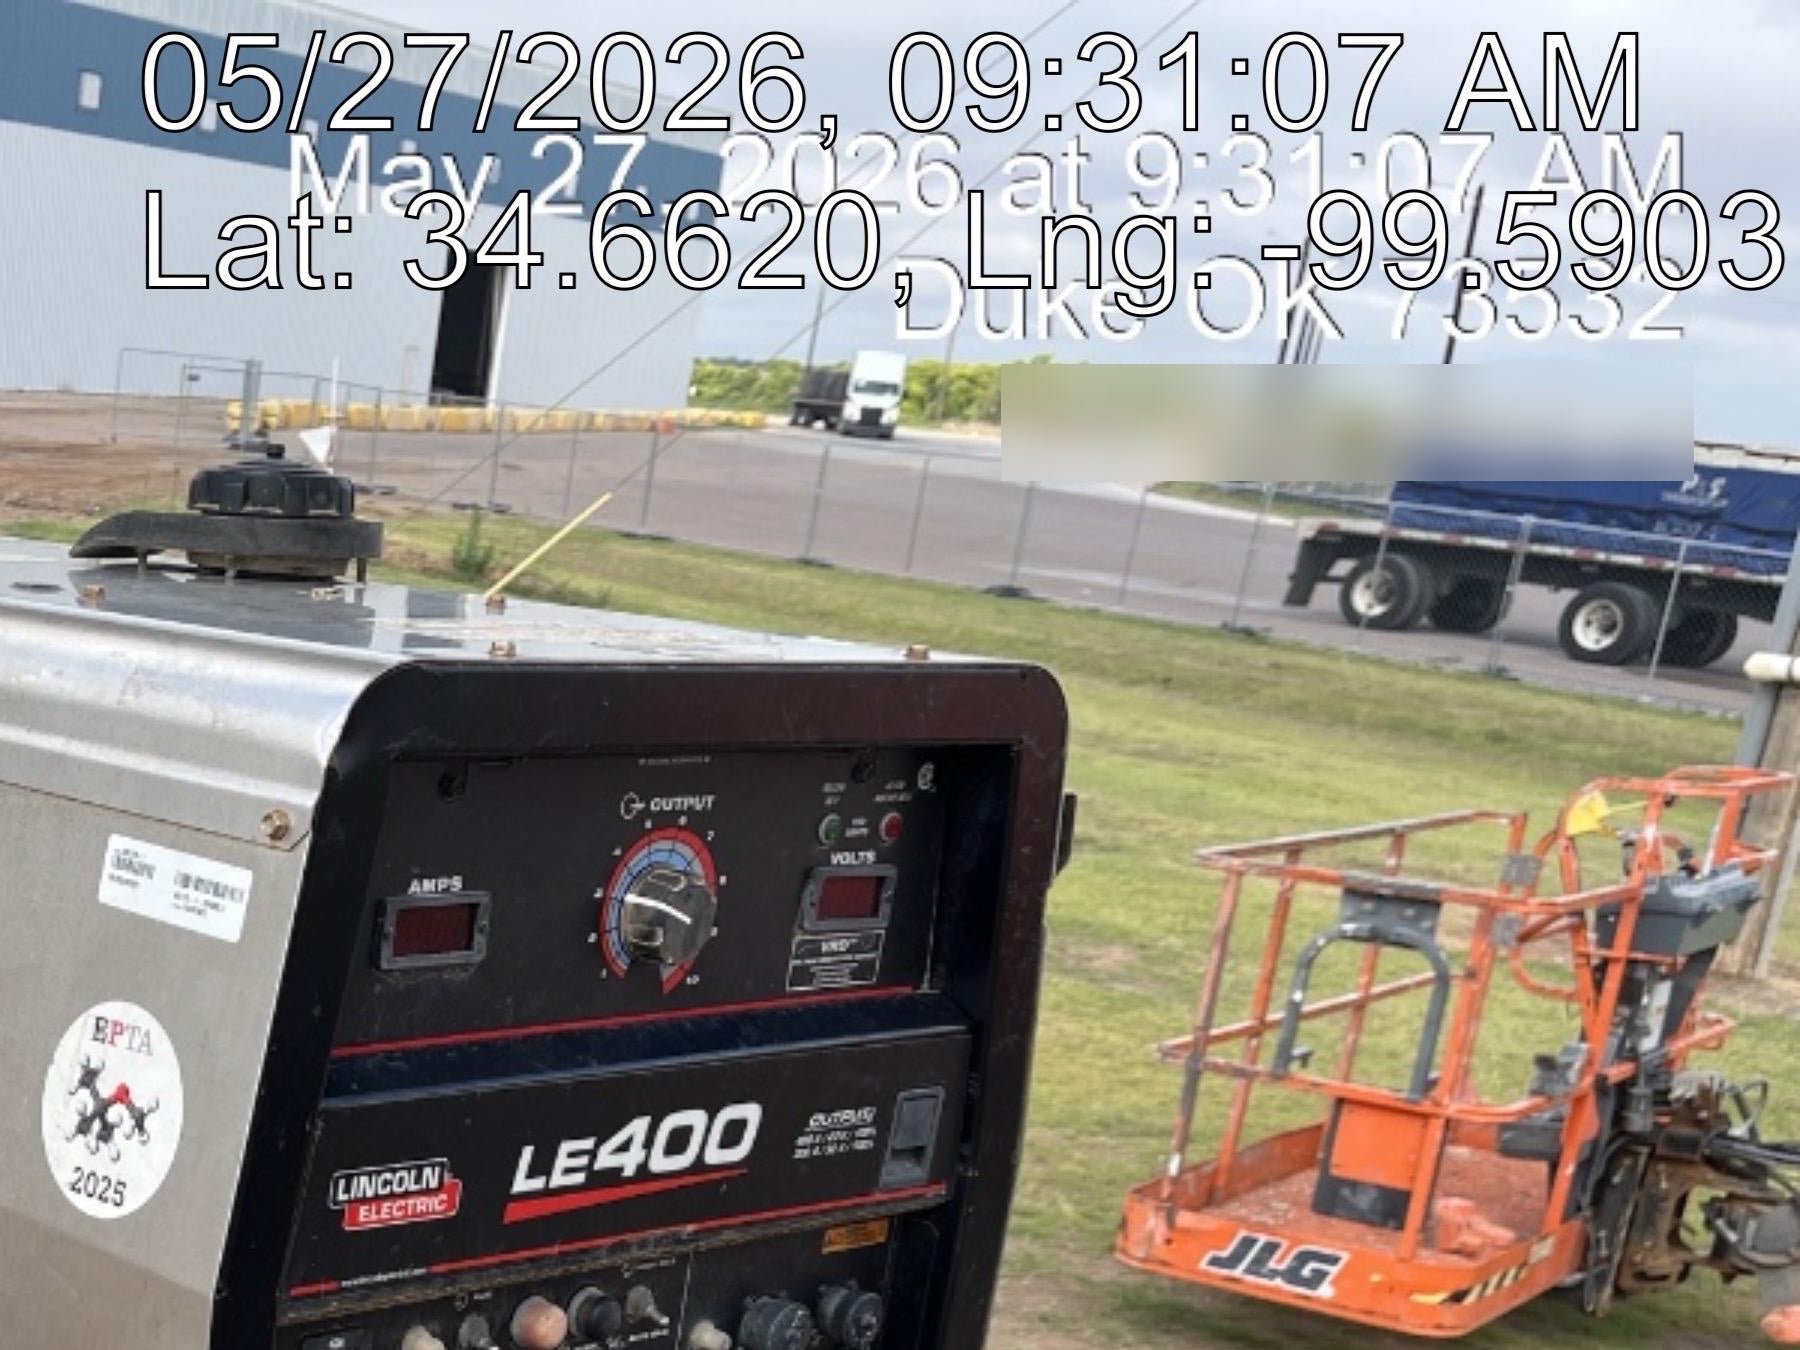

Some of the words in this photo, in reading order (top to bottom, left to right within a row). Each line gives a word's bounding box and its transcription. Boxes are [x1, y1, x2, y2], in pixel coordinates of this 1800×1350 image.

[650, 795, 717, 812] OUTPUT
[830, 850, 877, 866] VOLTS
[407, 875, 463, 896] AMPS
[92, 1016, 154, 1057] EPTA
[510, 1102, 764, 1195] LE400
[70, 1166, 128, 1208] 2025
[337, 1166, 441, 1201] LINCOLN
[359, 1193, 449, 1222] ELECTRIC
[1203, 1234, 1345, 1292] JLG
